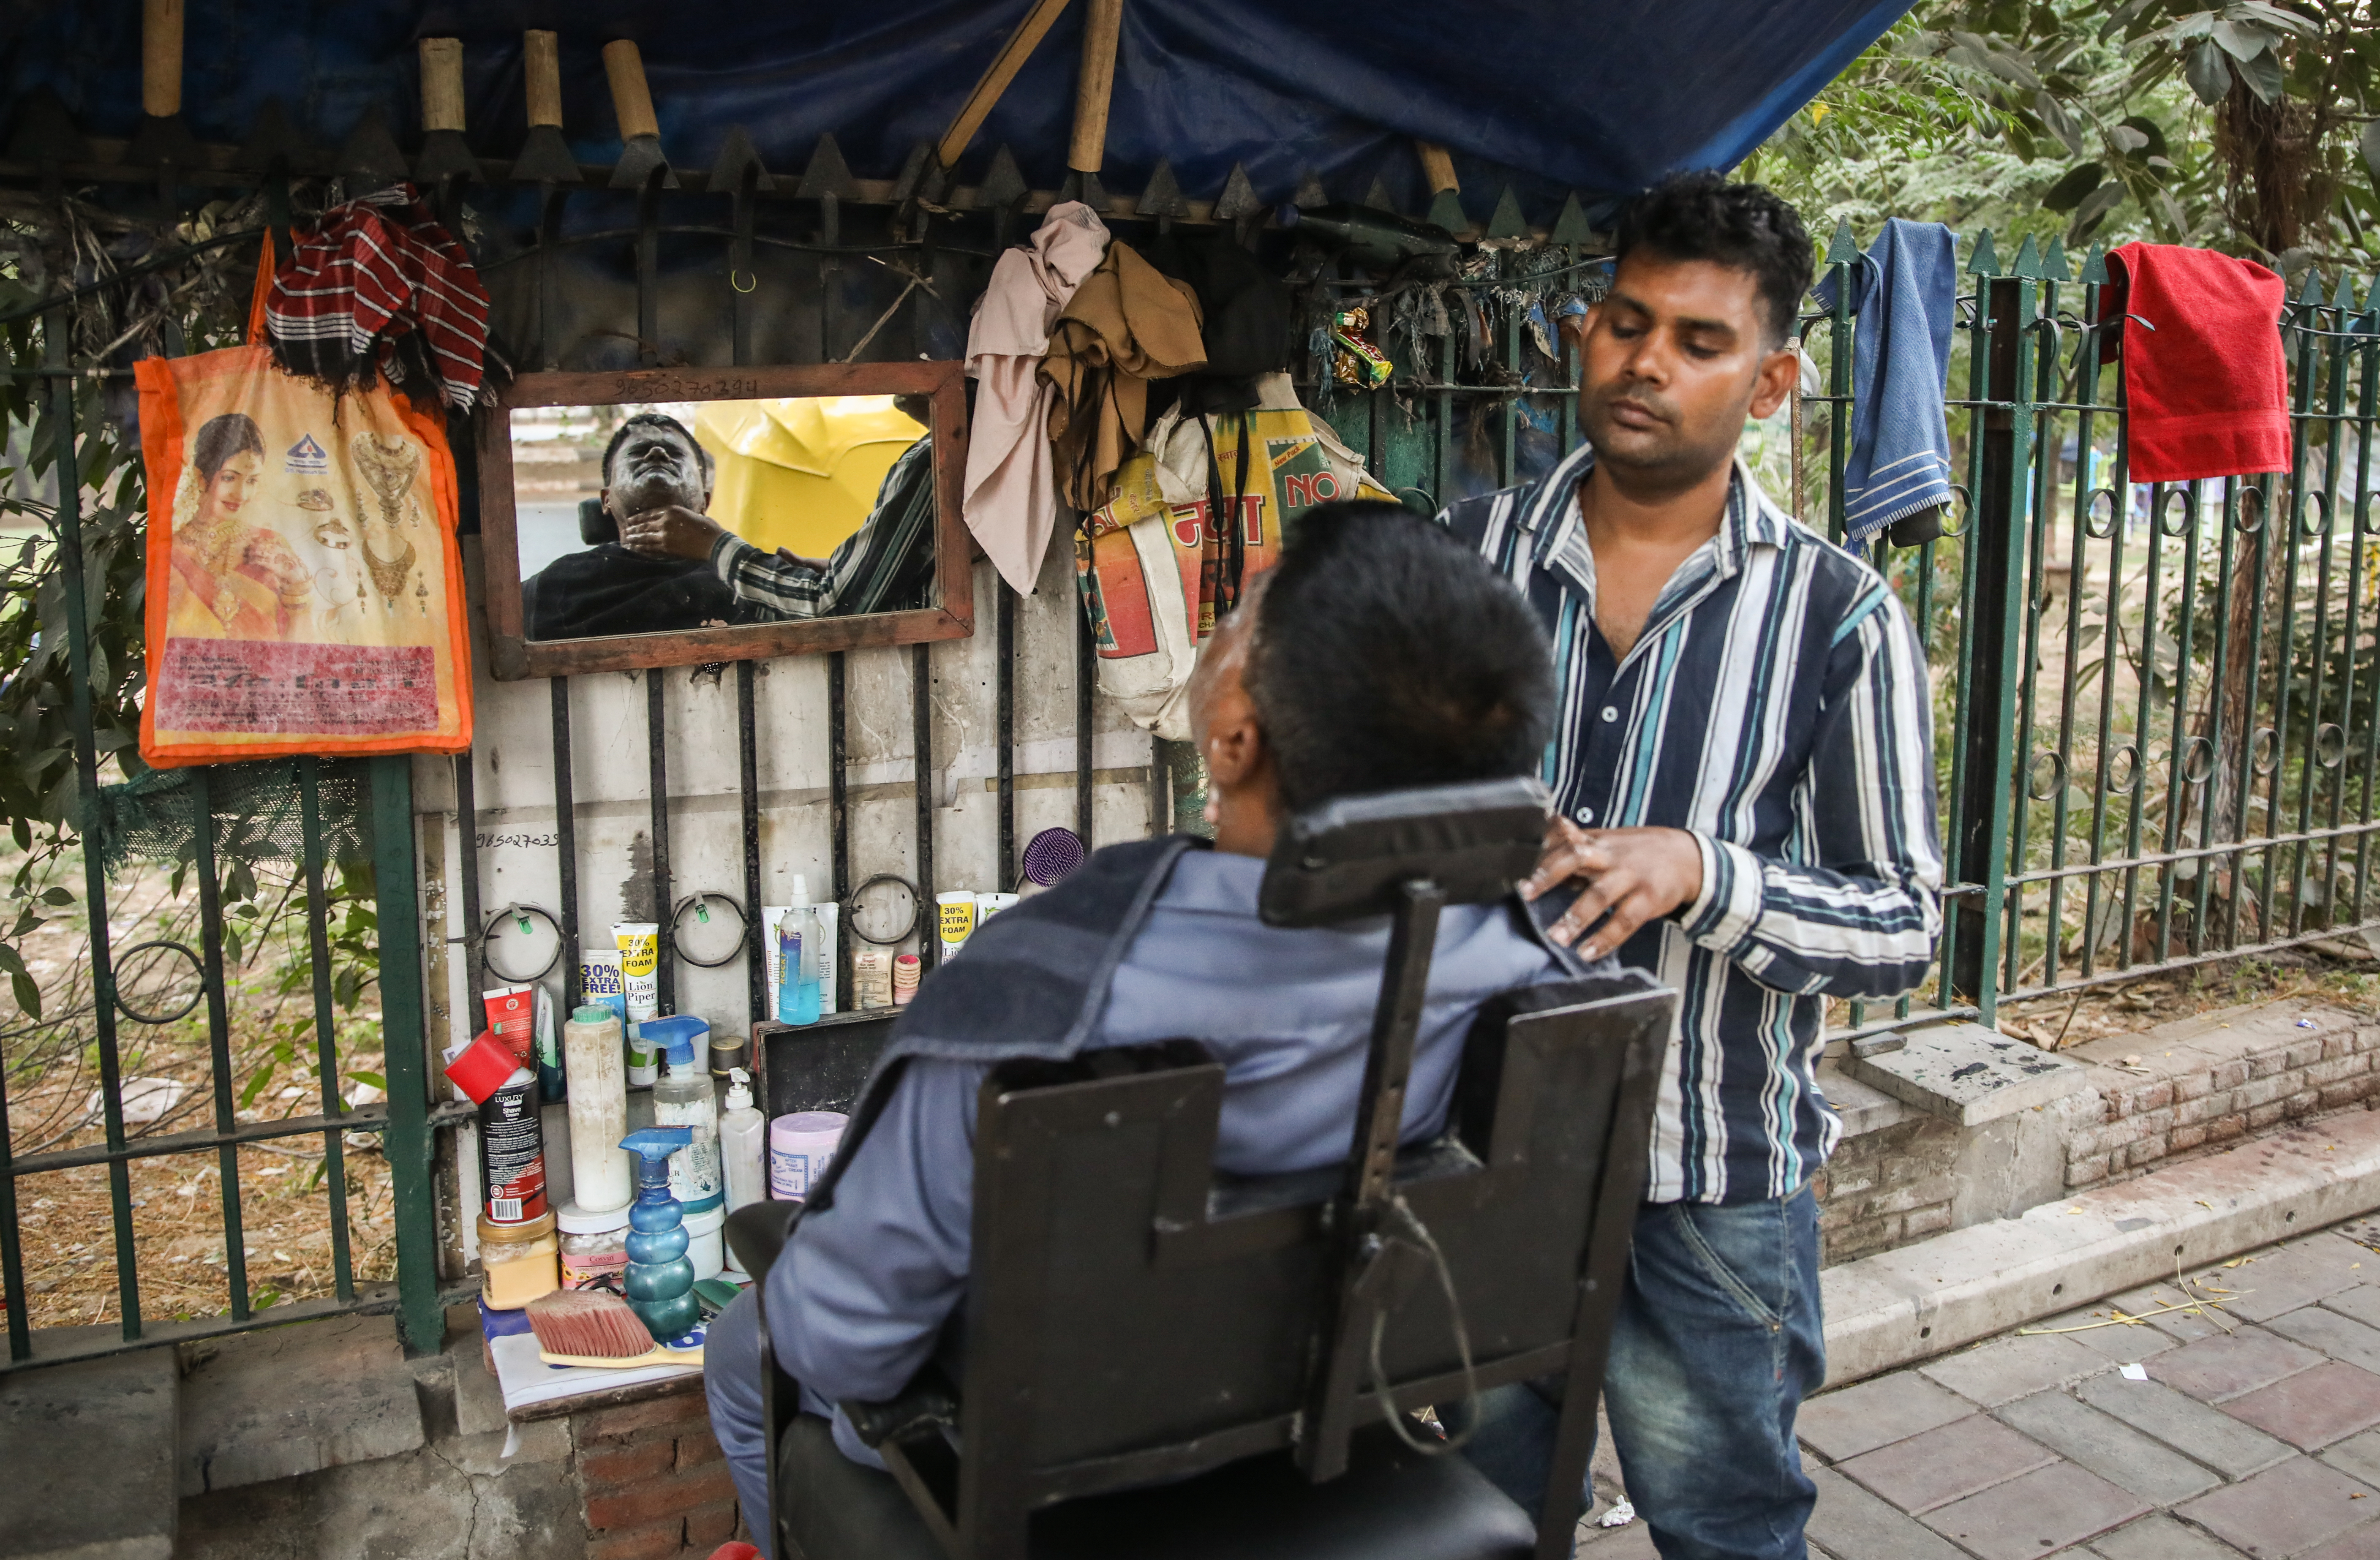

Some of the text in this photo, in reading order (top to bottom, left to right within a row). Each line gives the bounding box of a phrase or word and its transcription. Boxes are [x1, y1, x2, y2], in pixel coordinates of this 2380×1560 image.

[1274, 445, 1302, 467] New Pack
[944, 907, 964, 915] 30%
[940, 916, 969, 924] EXTRA
[628, 939, 650, 947] 30%
[622, 948, 654, 958] EXTRA
[944, 947, 959, 956] Lio
[626, 958, 652, 967] FOAM
[580, 964, 620, 977] 30%
[582, 984, 621, 994] FREE!
[629, 981, 653, 991] Lion
[628, 992, 655, 1004] Piper
[495, 1093, 525, 1103] LUXURY
